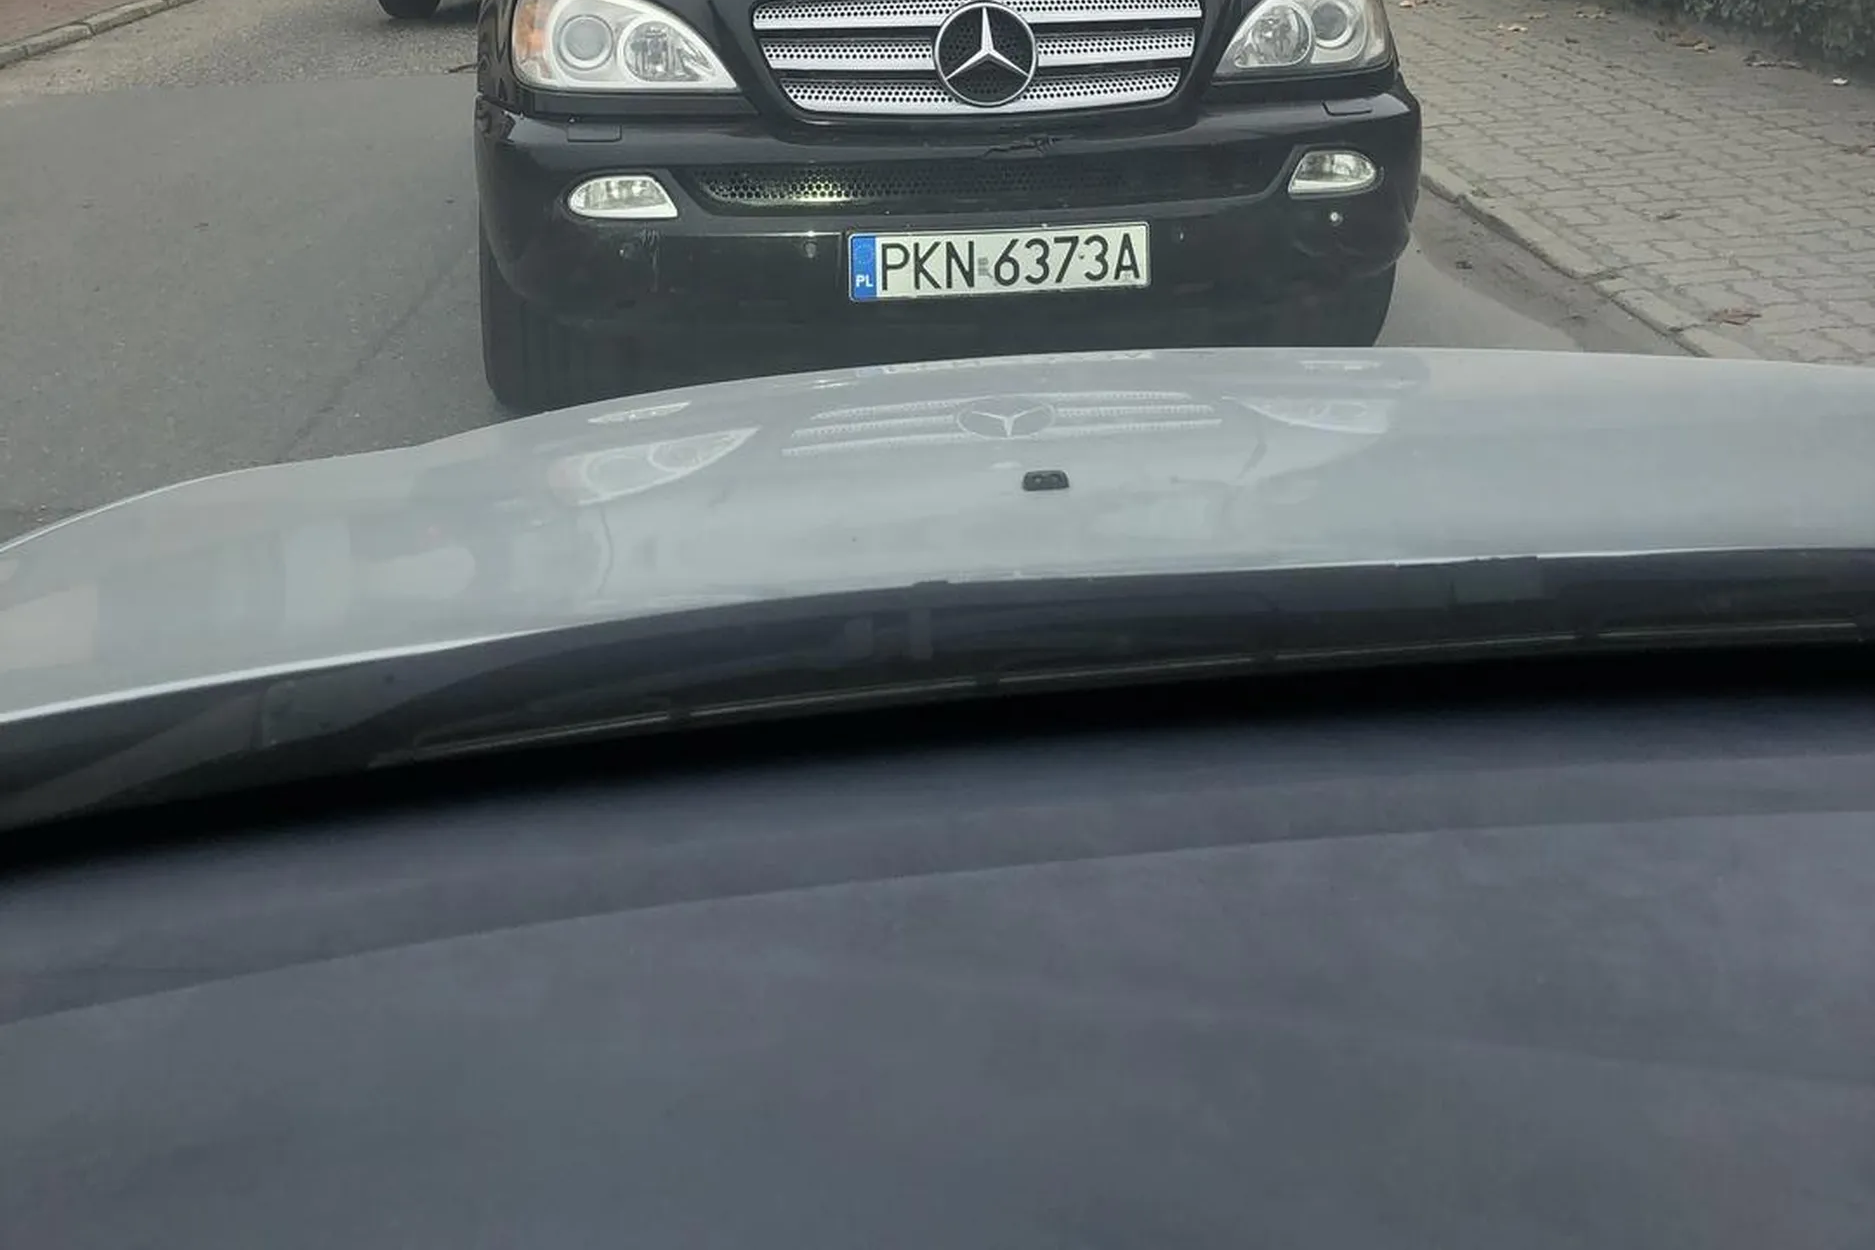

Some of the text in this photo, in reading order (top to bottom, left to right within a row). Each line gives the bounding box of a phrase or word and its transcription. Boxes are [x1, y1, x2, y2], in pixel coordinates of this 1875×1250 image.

[881, 233, 1140, 291] PKN 6373A
[855, 274, 874, 288] PL
